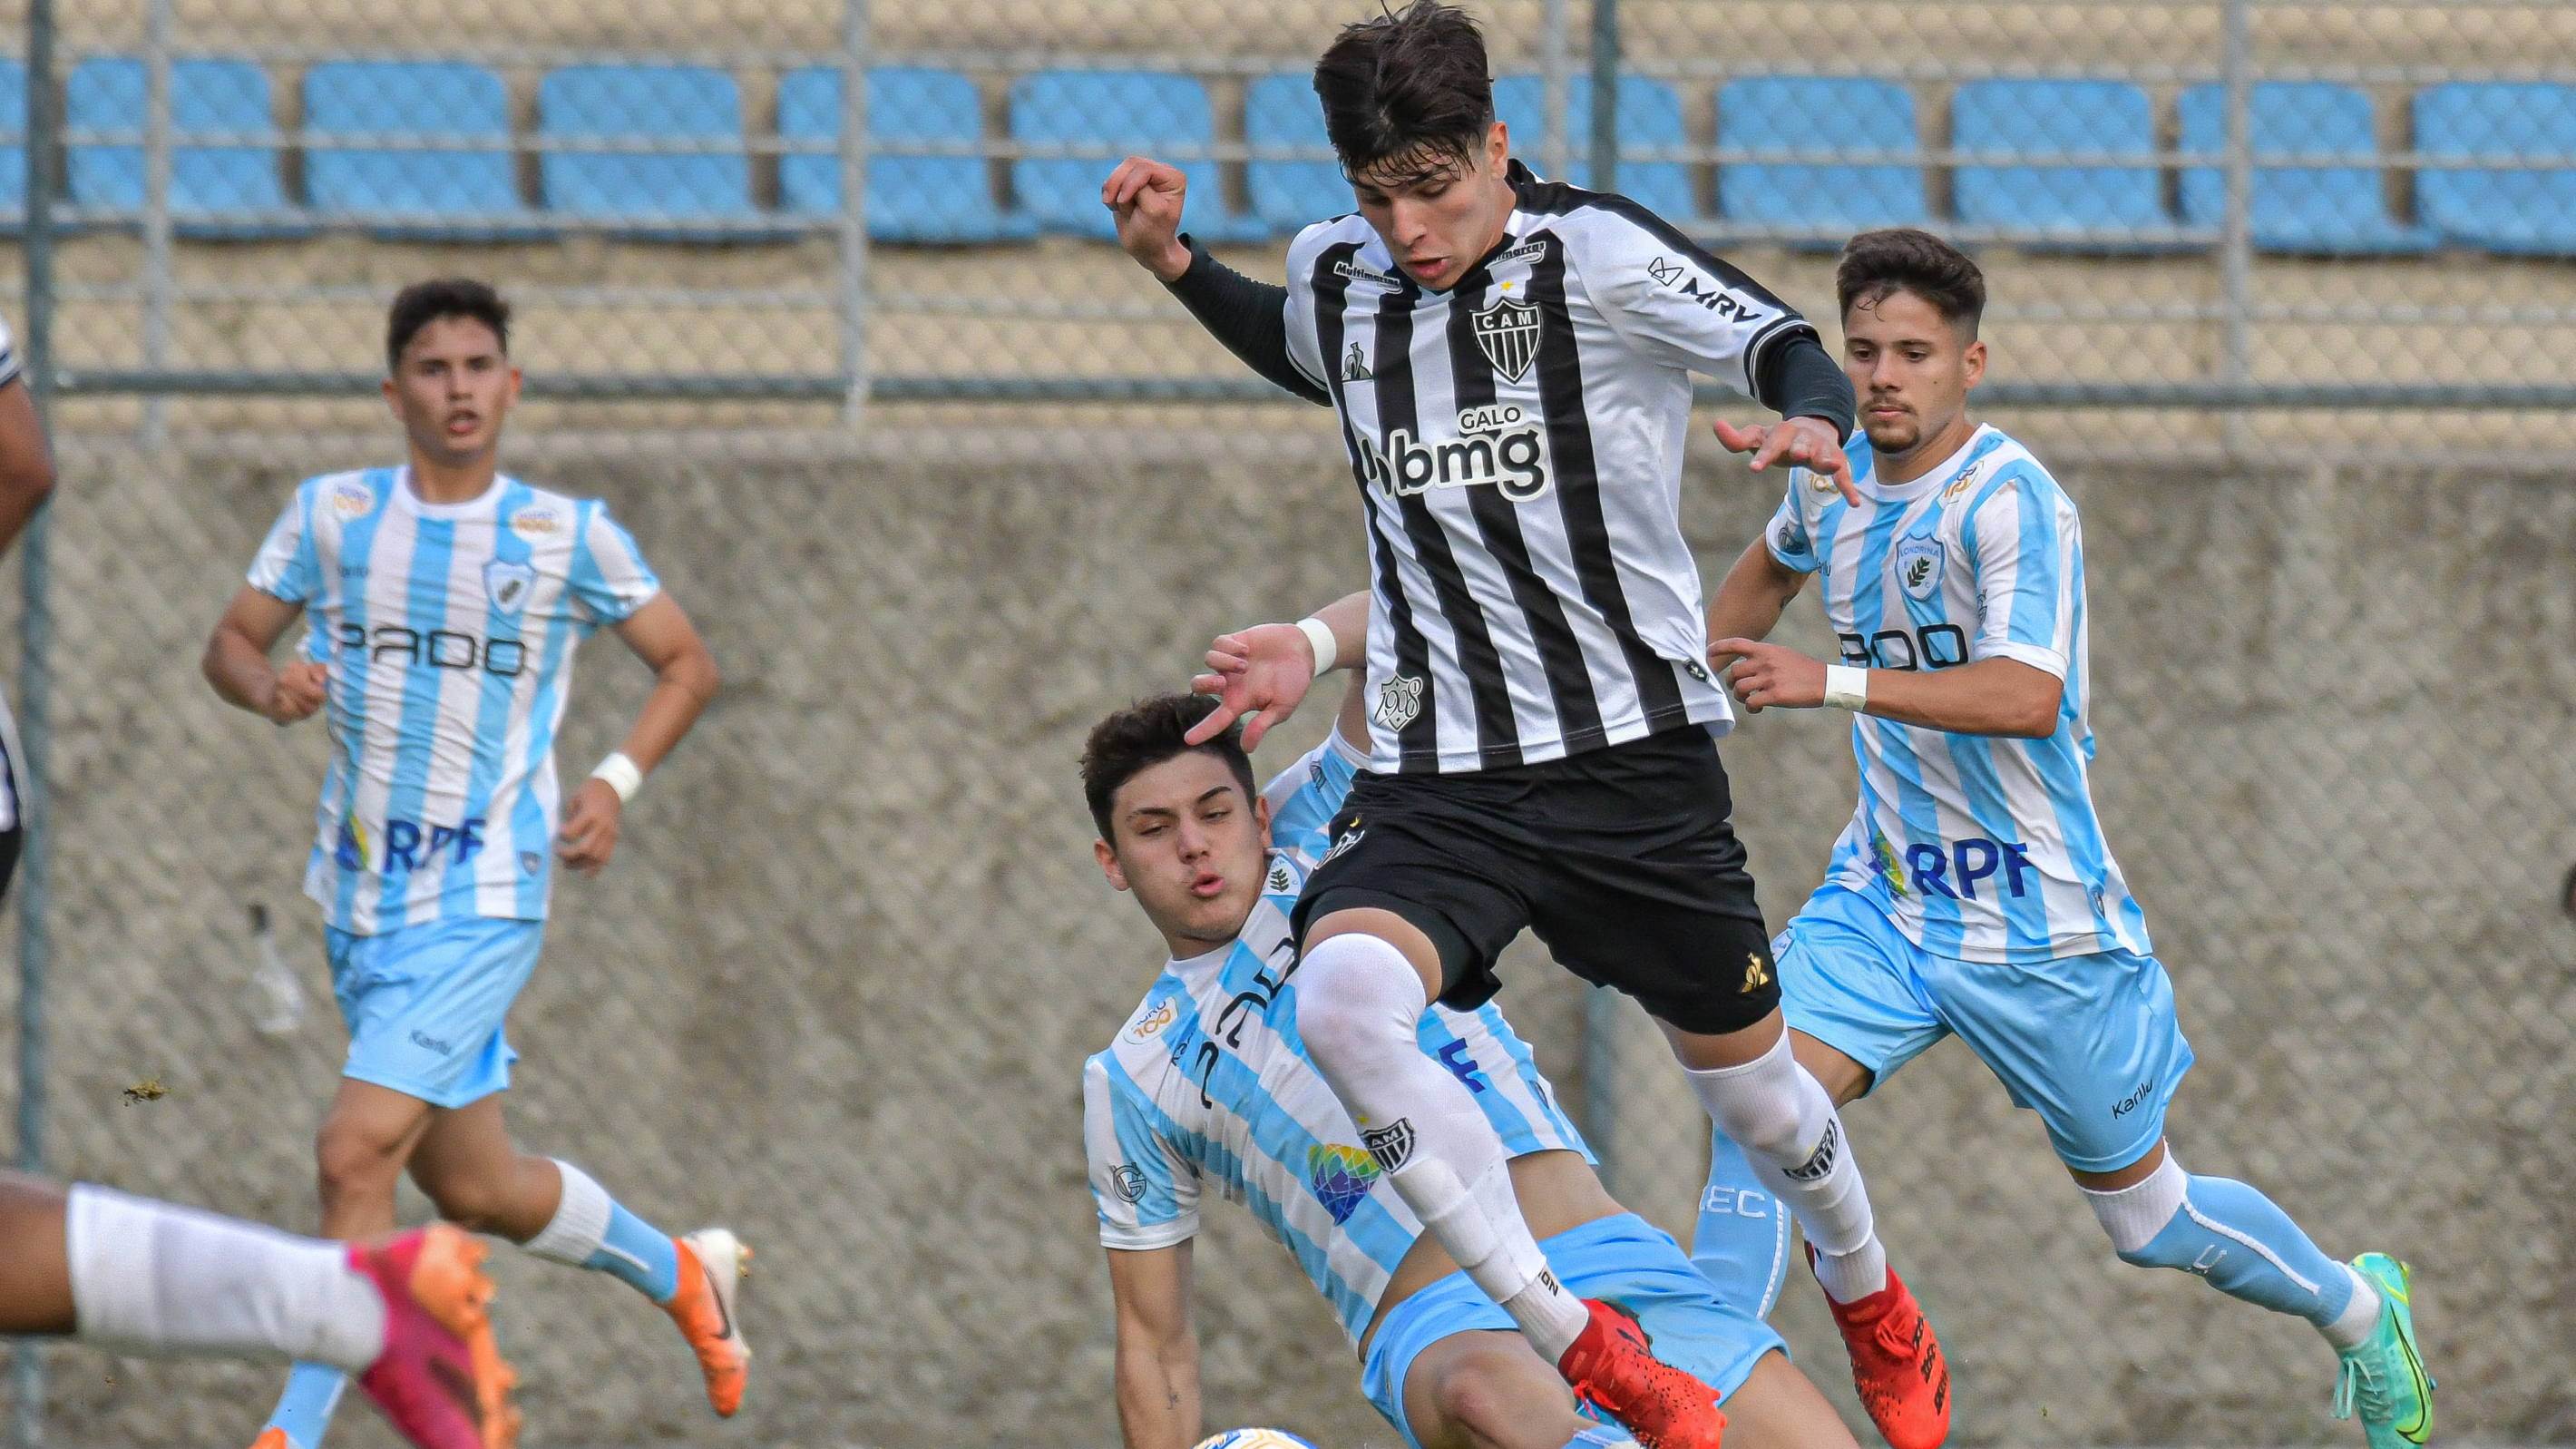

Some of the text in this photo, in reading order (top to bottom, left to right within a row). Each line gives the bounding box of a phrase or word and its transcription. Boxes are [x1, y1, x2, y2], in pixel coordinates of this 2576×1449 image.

[1482, 311, 1532, 328] CAM
[1678, 277, 1761, 323] MRV
[1460, 406, 1521, 430] GALO
[1394, 428, 1545, 497] bmg
[1374, 679, 1421, 727] 1908
